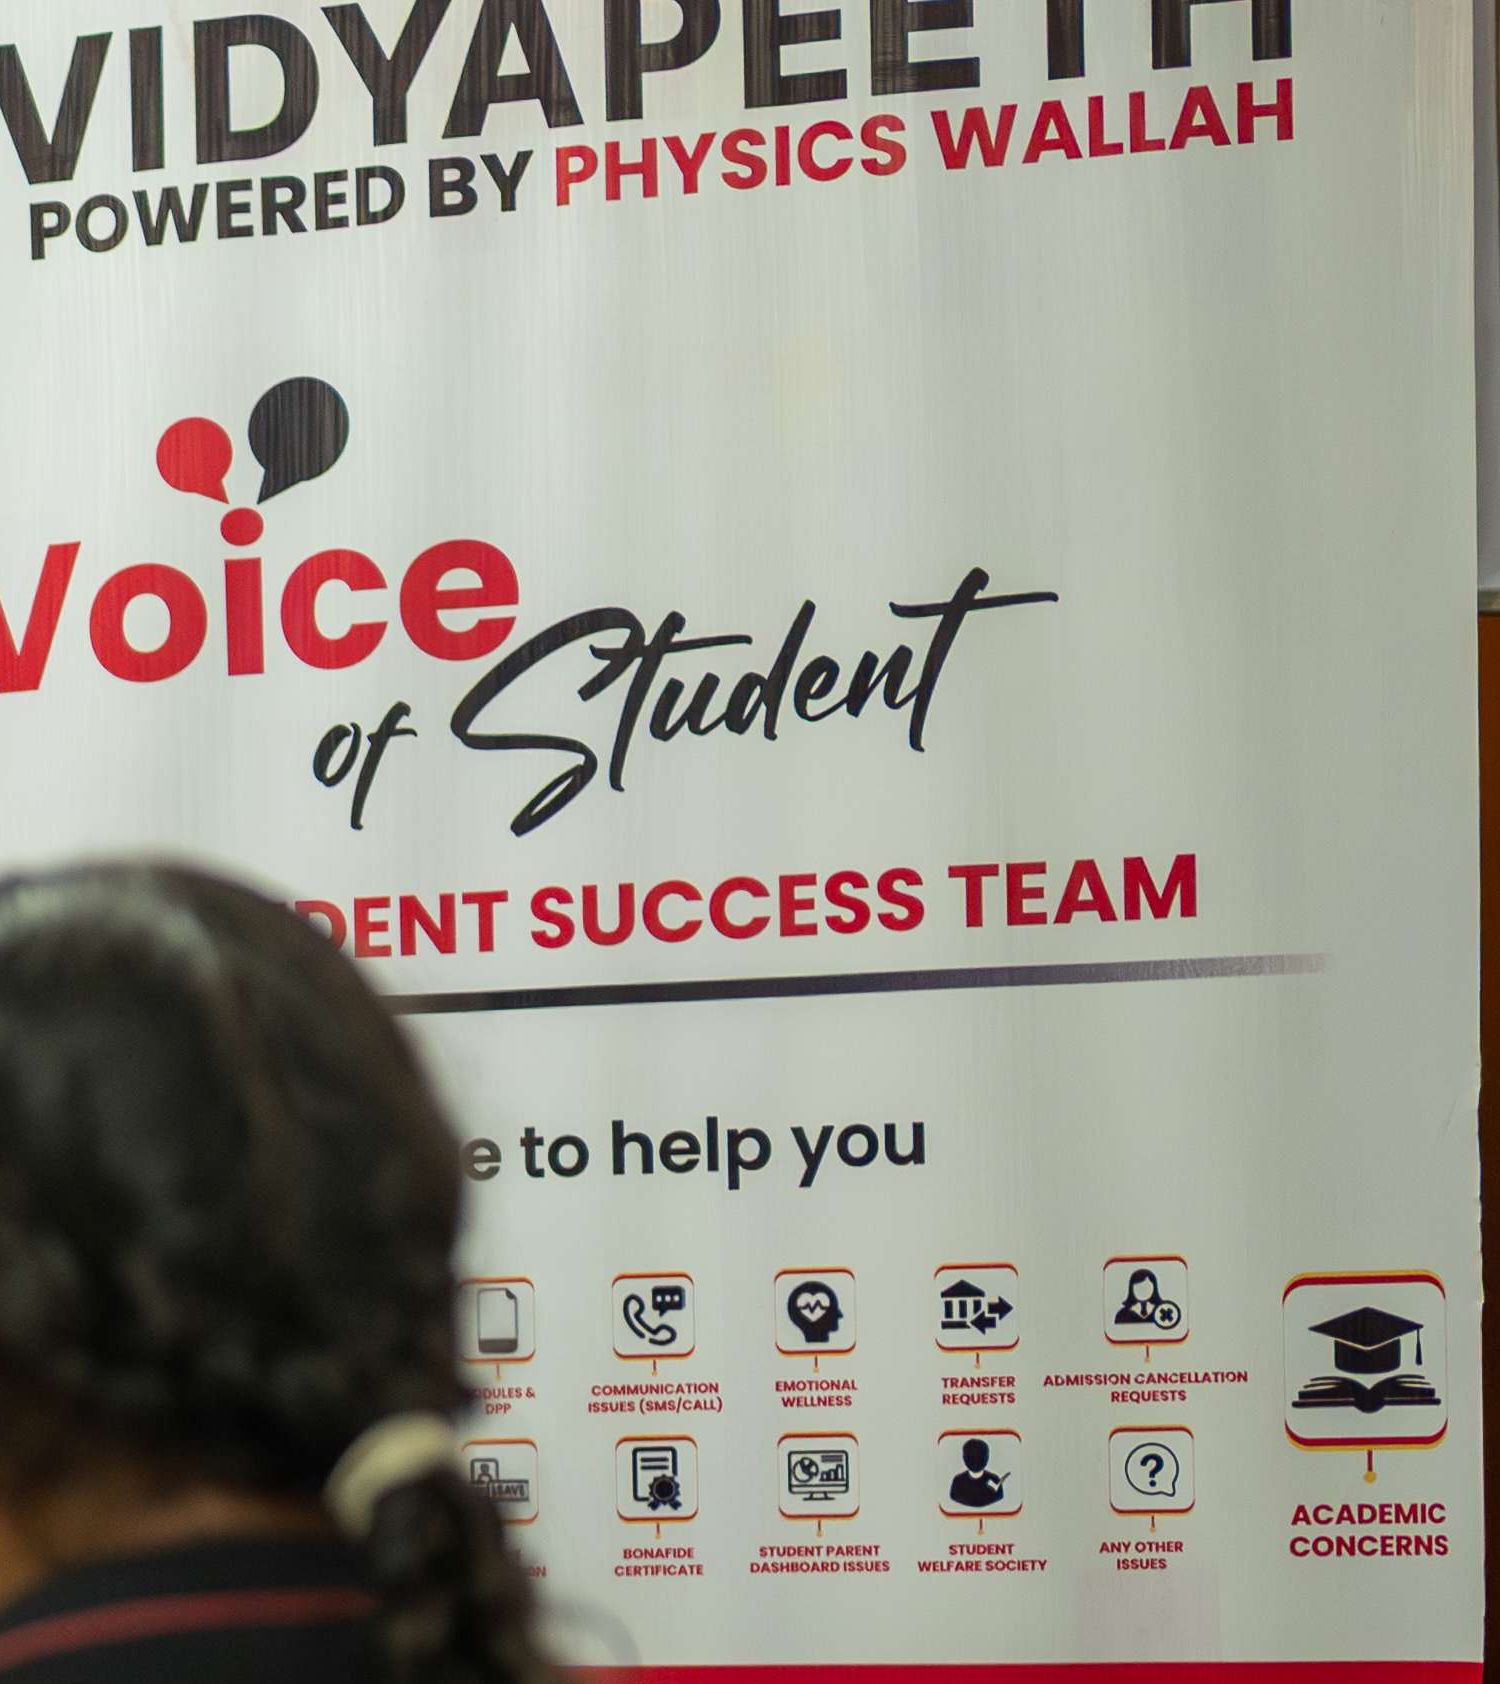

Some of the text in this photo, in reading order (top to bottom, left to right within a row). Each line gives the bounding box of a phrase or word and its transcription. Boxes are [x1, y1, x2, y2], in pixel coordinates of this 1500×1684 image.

[29, 78, 1294, 261] POWERED BY PHYSICS WALLAH
[313, 566, 1059, 837] of Student
[284, 853, 1198, 959] DENT SUCCESS TEAM
[520, 1126, 590, 1178] to
[611, 1116, 772, 1190] help
[790, 1121, 926, 1188] you
[775, 1378, 859, 1393] EMOTIONAL
[942, 1375, 1016, 1389] TRANSFER
[1043, 1370, 1248, 1388] ADMISSION CANCELLATION
[475, 1387, 523, 1400] DULES
[591, 1382, 720, 1397] COMMUNICATION
[1110, 1388, 1187, 1404] REQUESTS
[588, 1396, 723, 1414] ISSUES (SMS/CALL)
[781, 1394, 853, 1408] WELLNESS
[941, 1392, 1016, 1406] REQUESTS
[1290, 1503, 1447, 1526] ACADEMIC
[622, 1545, 695, 1559] BONAFIDE
[759, 1544, 881, 1558] STUDENT PARENT
[949, 1542, 1014, 1557] STUDENT
[1099, 1540, 1184, 1555] ANY OTHER
[1289, 1535, 1449, 1558] CONCERNS
[614, 1562, 704, 1577] CERTIFICATE
[750, 1560, 891, 1574] DASHBOARD ISSUES
[917, 1558, 1048, 1573] WELFARE SOCIETY
[1116, 1557, 1167, 1571] ISSUES
